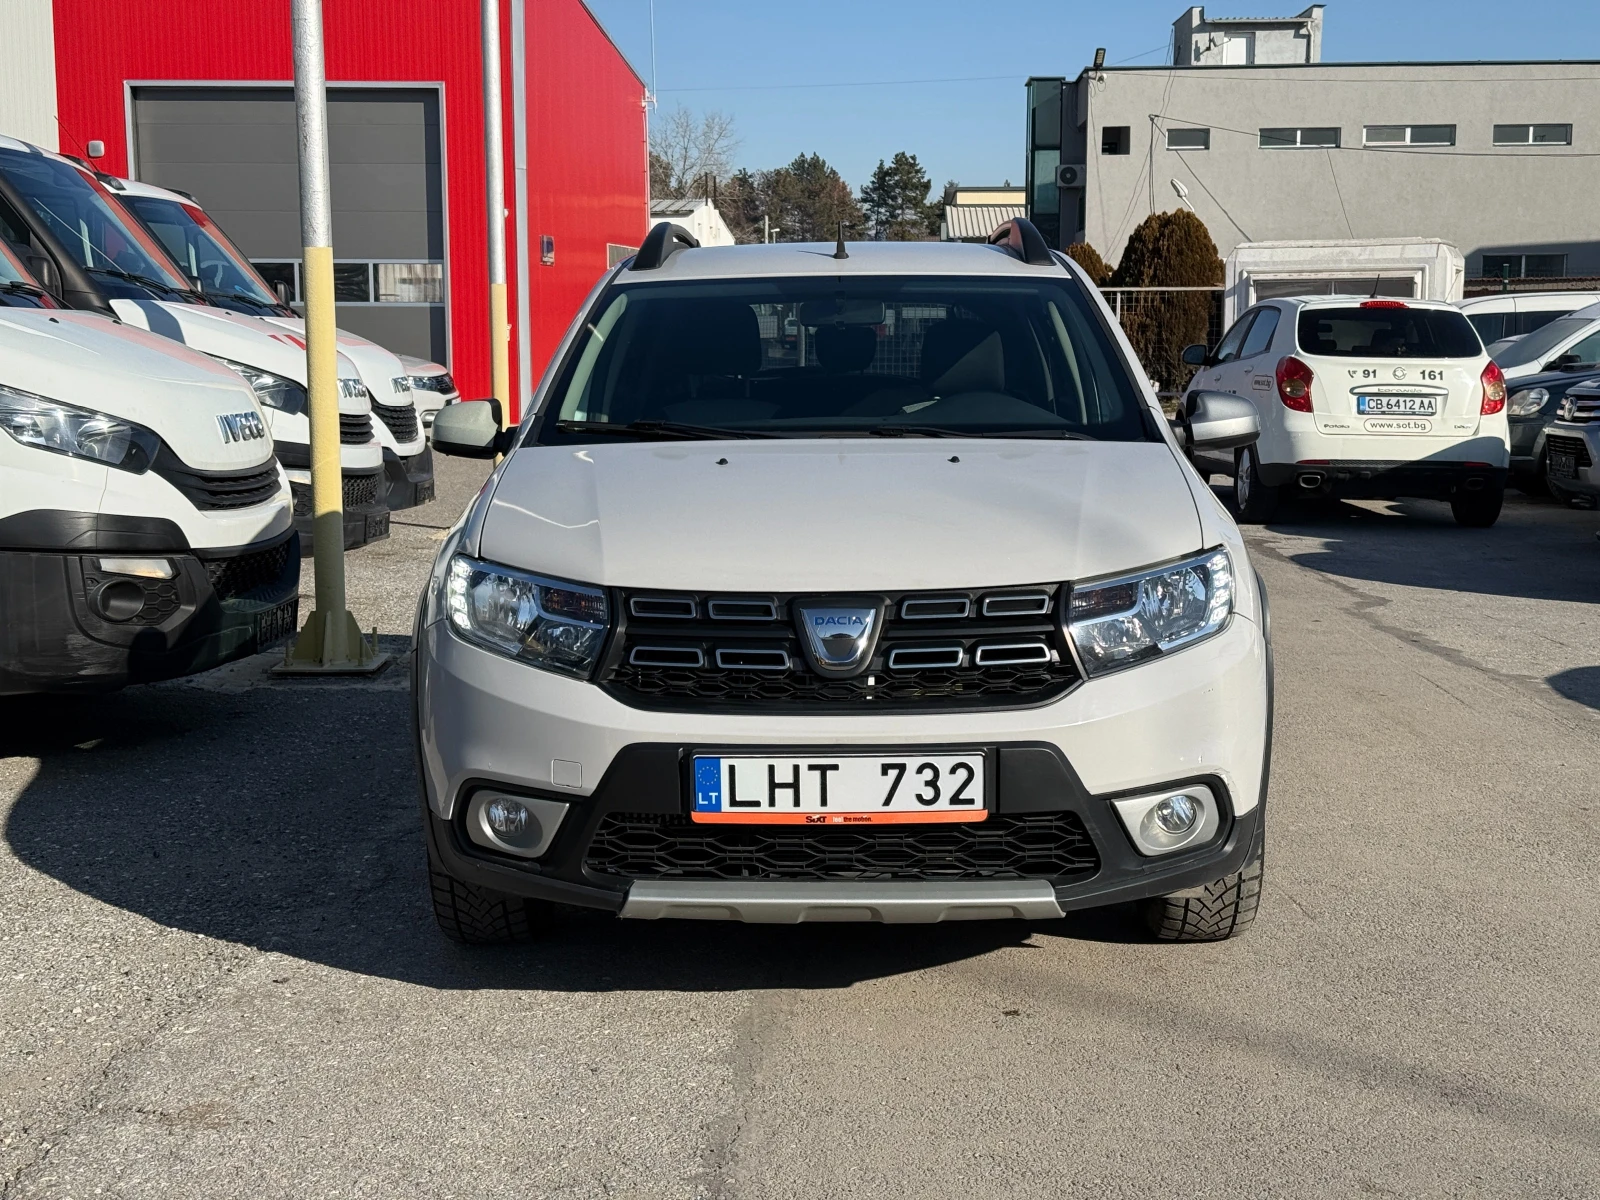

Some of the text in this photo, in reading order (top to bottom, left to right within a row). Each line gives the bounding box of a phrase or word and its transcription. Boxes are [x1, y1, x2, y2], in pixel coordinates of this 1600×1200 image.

[1362, 369, 1444, 381] 91 161
[1367, 398, 1383, 410] CB
[1386, 399, 1416, 410] 6412
[1419, 399, 1435, 411] AA
[215, 411, 265, 444] IVECO
[1370, 422, 1426, 431] www.sot.bg
[814, 616, 864, 626] DACIA
[728, 762, 976, 808] LHT 732
[698, 792, 719, 805] LT
